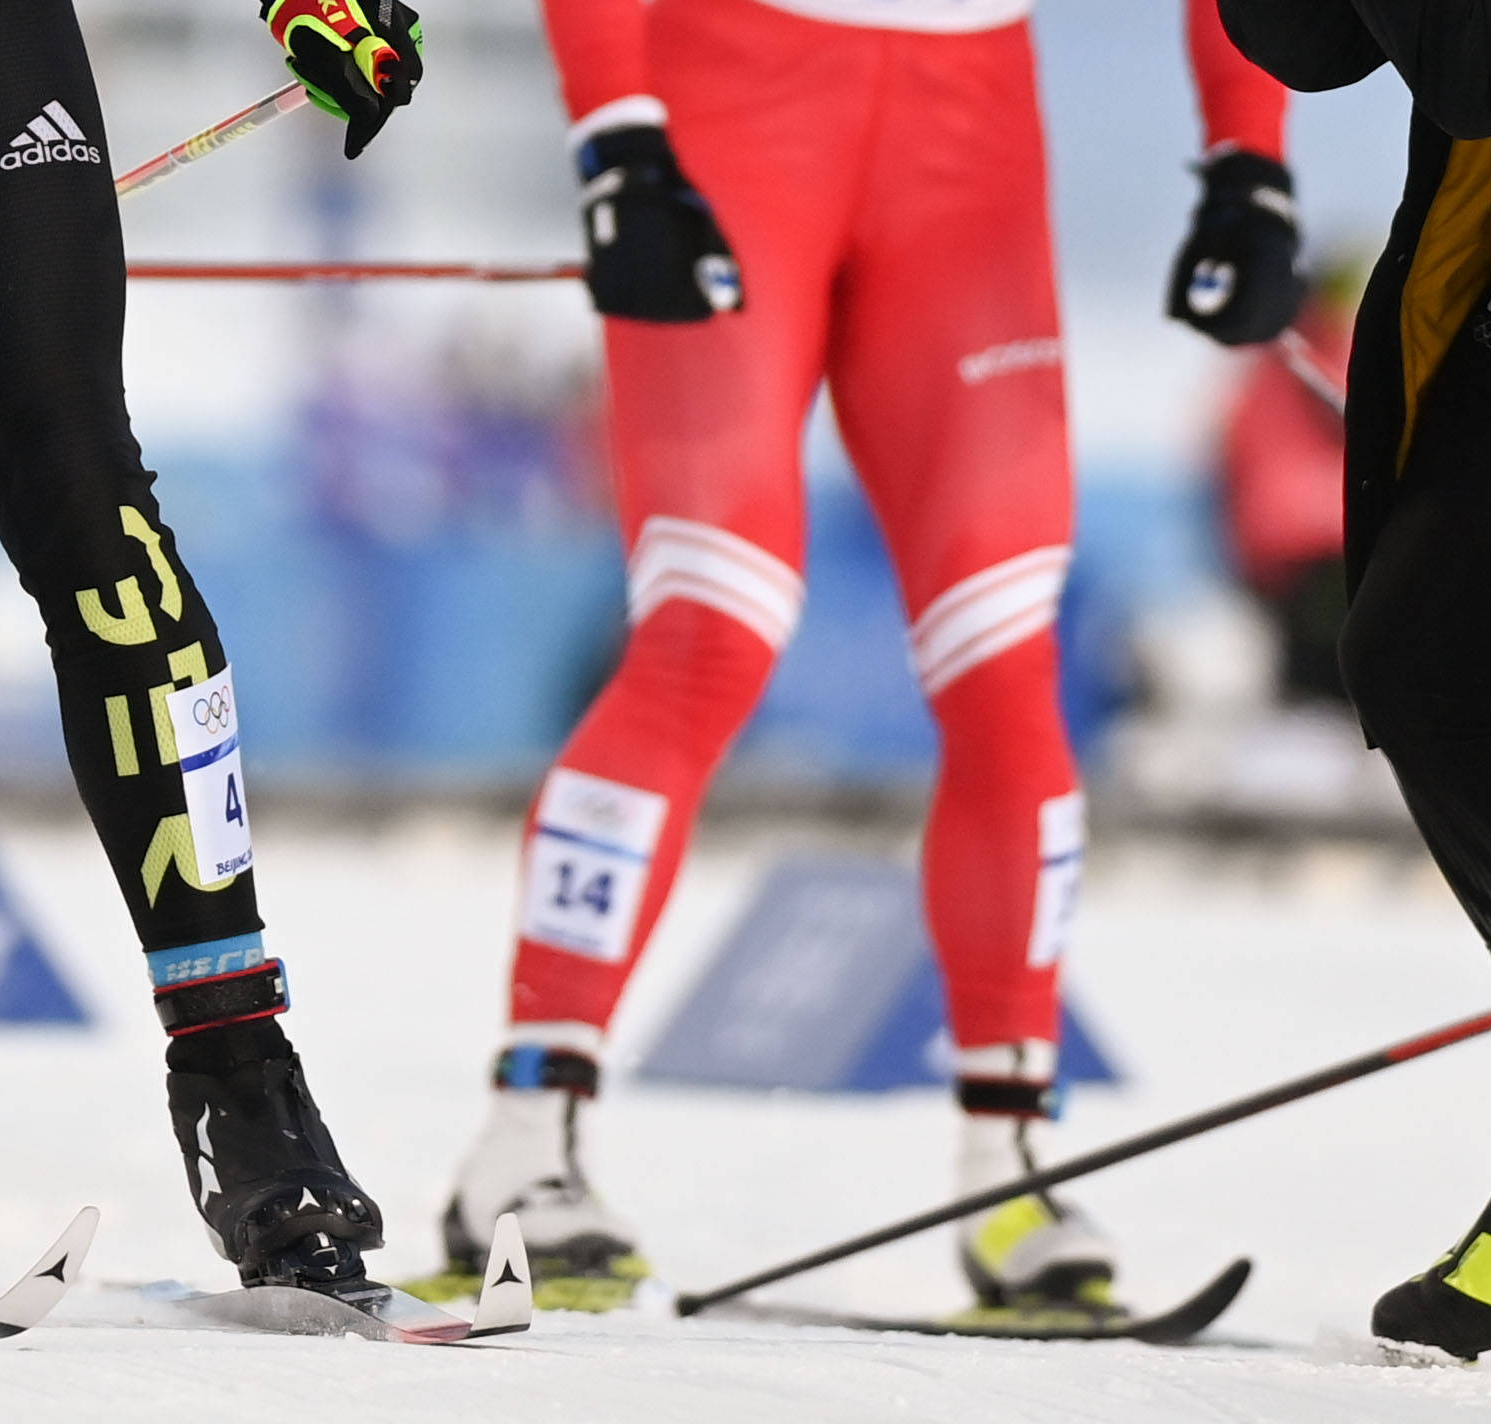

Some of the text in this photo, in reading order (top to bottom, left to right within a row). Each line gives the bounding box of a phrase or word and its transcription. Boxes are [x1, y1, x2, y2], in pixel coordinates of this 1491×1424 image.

[0, 138, 101, 170] adidas
[226, 772, 243, 828] 4
[553, 860, 613, 915] 14
